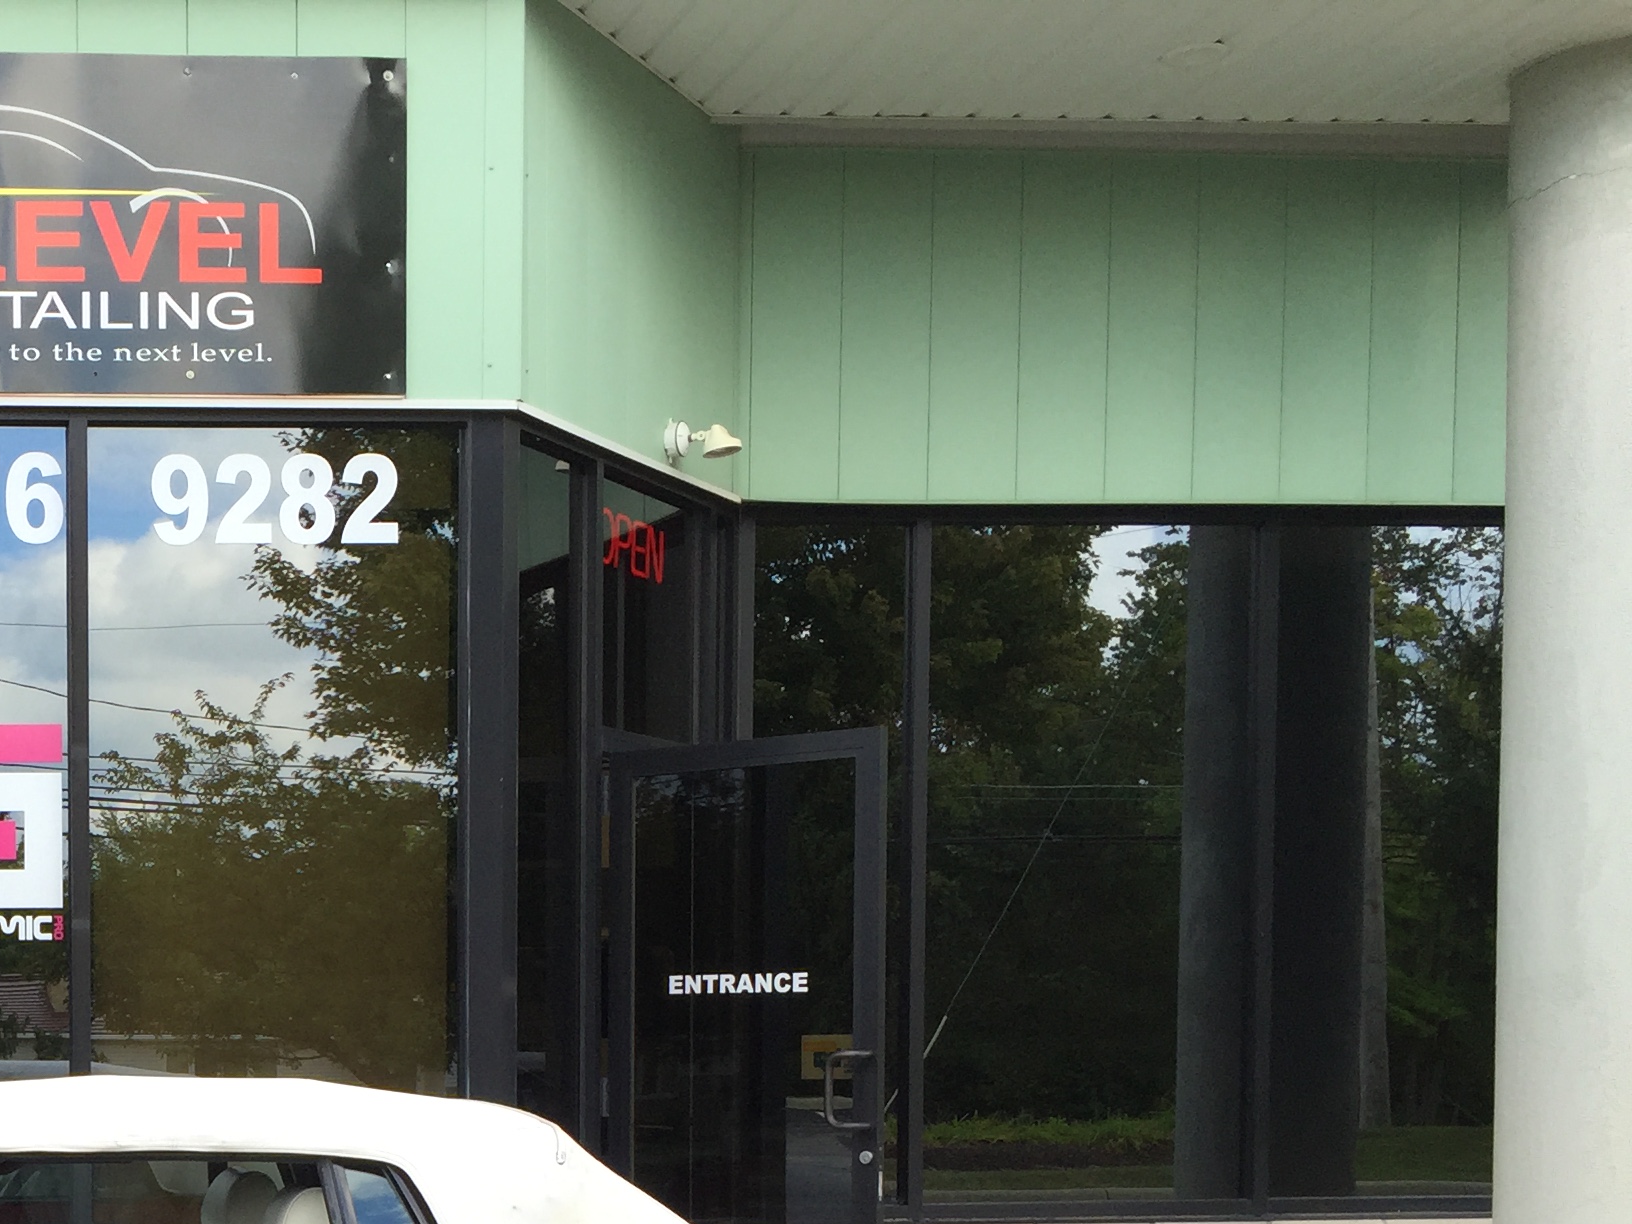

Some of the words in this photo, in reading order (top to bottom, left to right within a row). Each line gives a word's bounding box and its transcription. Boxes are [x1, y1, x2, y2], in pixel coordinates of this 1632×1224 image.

[8, 343, 41, 362] to
[52, 342, 103, 362] the
[112, 345, 182, 363] next
[190, 342, 274, 363] level.
[150, 452, 401, 546] 9282
[668, 971, 809, 995] ENTRANCE
